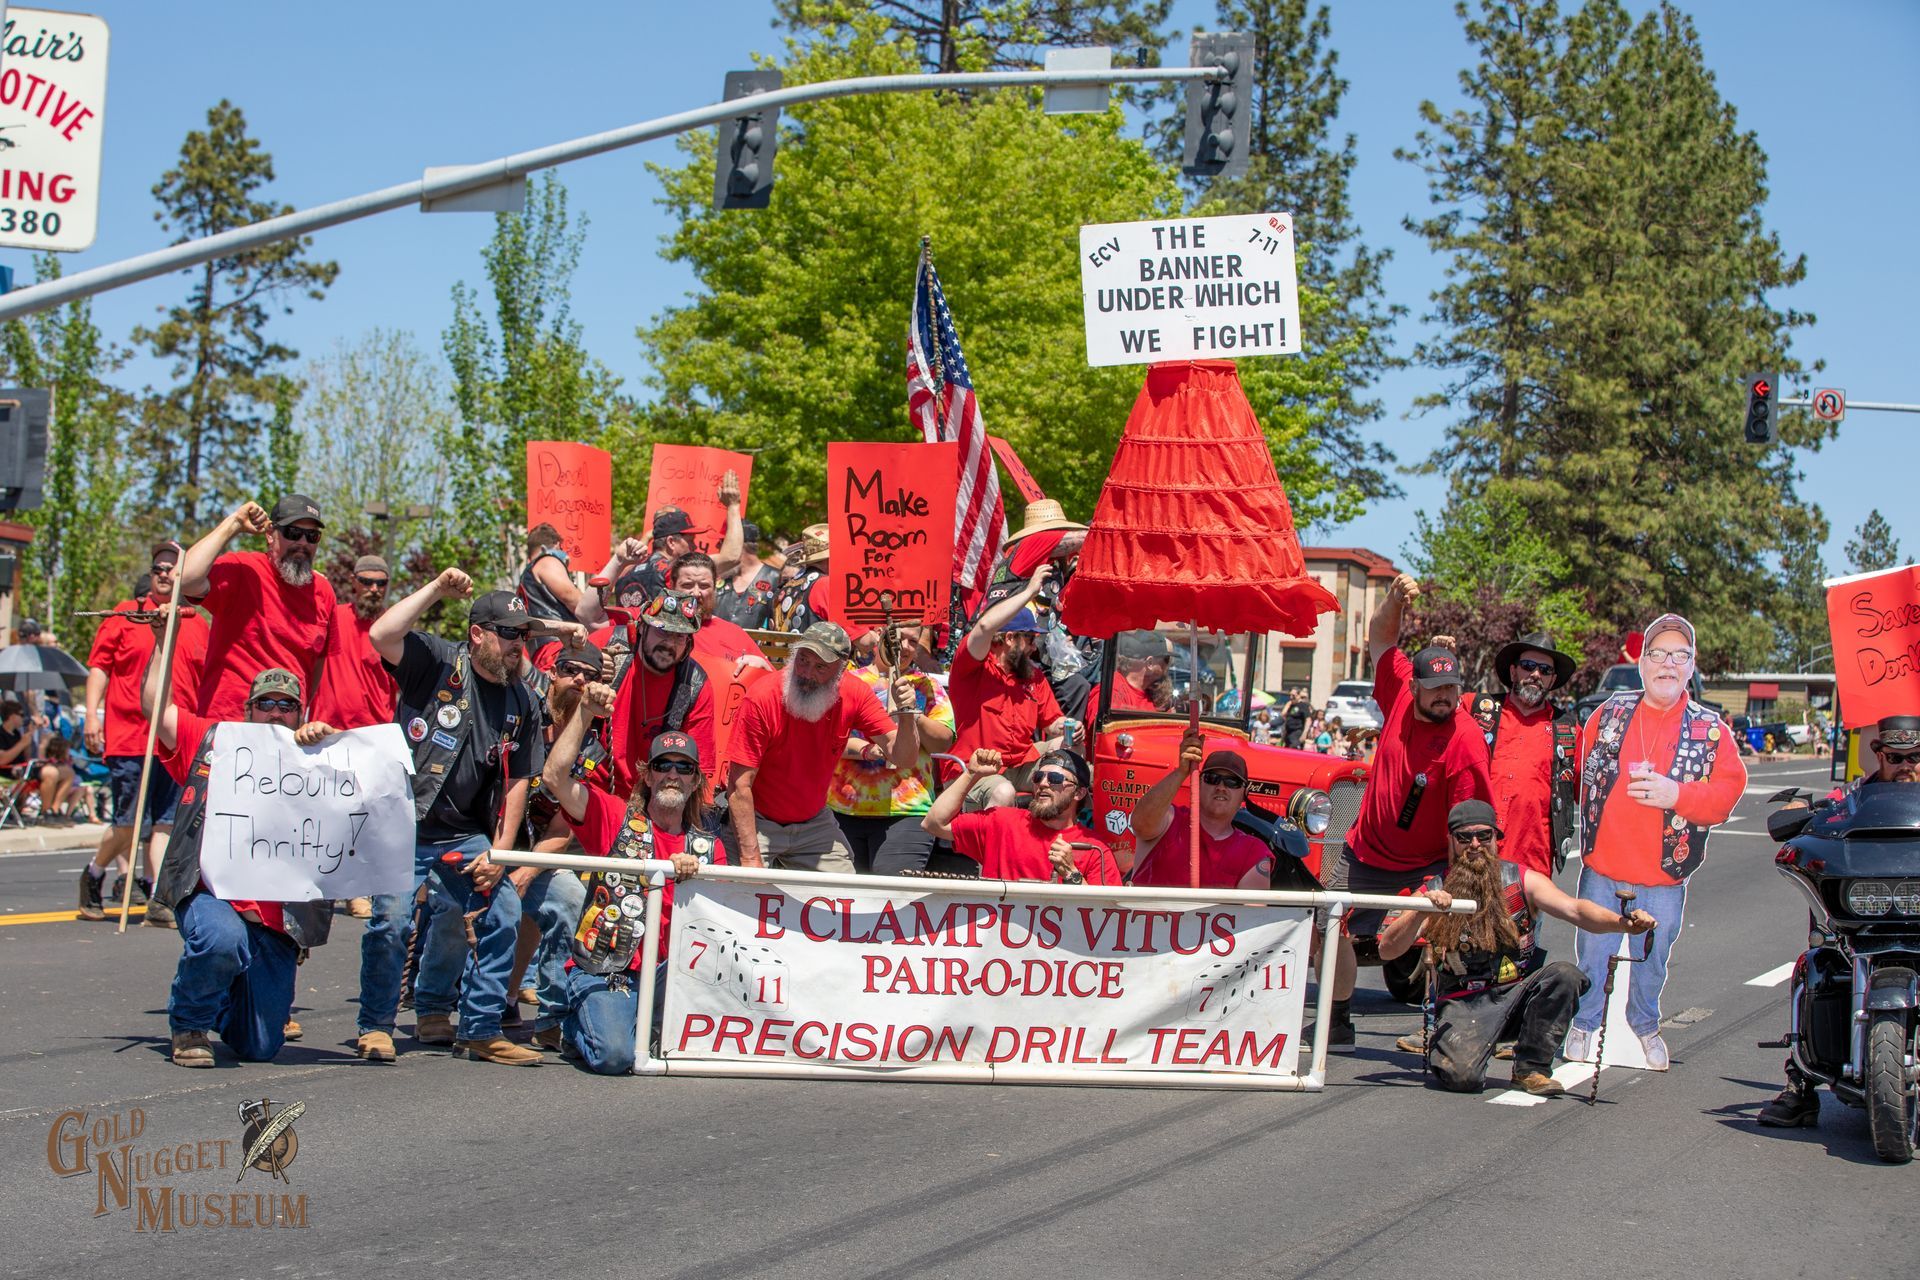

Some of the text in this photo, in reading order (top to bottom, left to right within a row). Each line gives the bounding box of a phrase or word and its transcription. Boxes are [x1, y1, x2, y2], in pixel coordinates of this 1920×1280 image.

[2, 169, 76, 203] ING
[1088, 237, 1121, 268] ECV
[1152, 225, 1205, 250] THE
[1248, 228, 1279, 255] 7-11
[1140, 254, 1243, 282] BANNER
[1098, 280, 1281, 313] UNDER WHICH
[1120, 318, 1286, 353] WE FIGHT!
[660, 456, 695, 480] Gold
[844, 467, 929, 517] Make
[847, 513, 928, 550] Room
[864, 548, 896, 565] For
[845, 573, 938, 608] Boom!!
[1851, 592, 1920, 637] Save
[264, 672, 290, 684] ECV
[234, 746, 356, 797] Rebuild
[1126, 769, 1135, 780] E
[1109, 820, 1116, 831] 7
[215, 811, 369, 875] Thrifty!
[754, 893, 1236, 957] E CLAMPUS VITUS
[688, 941, 708, 970] 7
[754, 975, 784, 1004] 11
[861, 955, 1125, 999] PAIR-O-DICE
[1262, 963, 1290, 991] 11
[1199, 987, 1214, 1012] 7
[677, 1013, 1288, 1069] PRECISION DRILL TEAM
